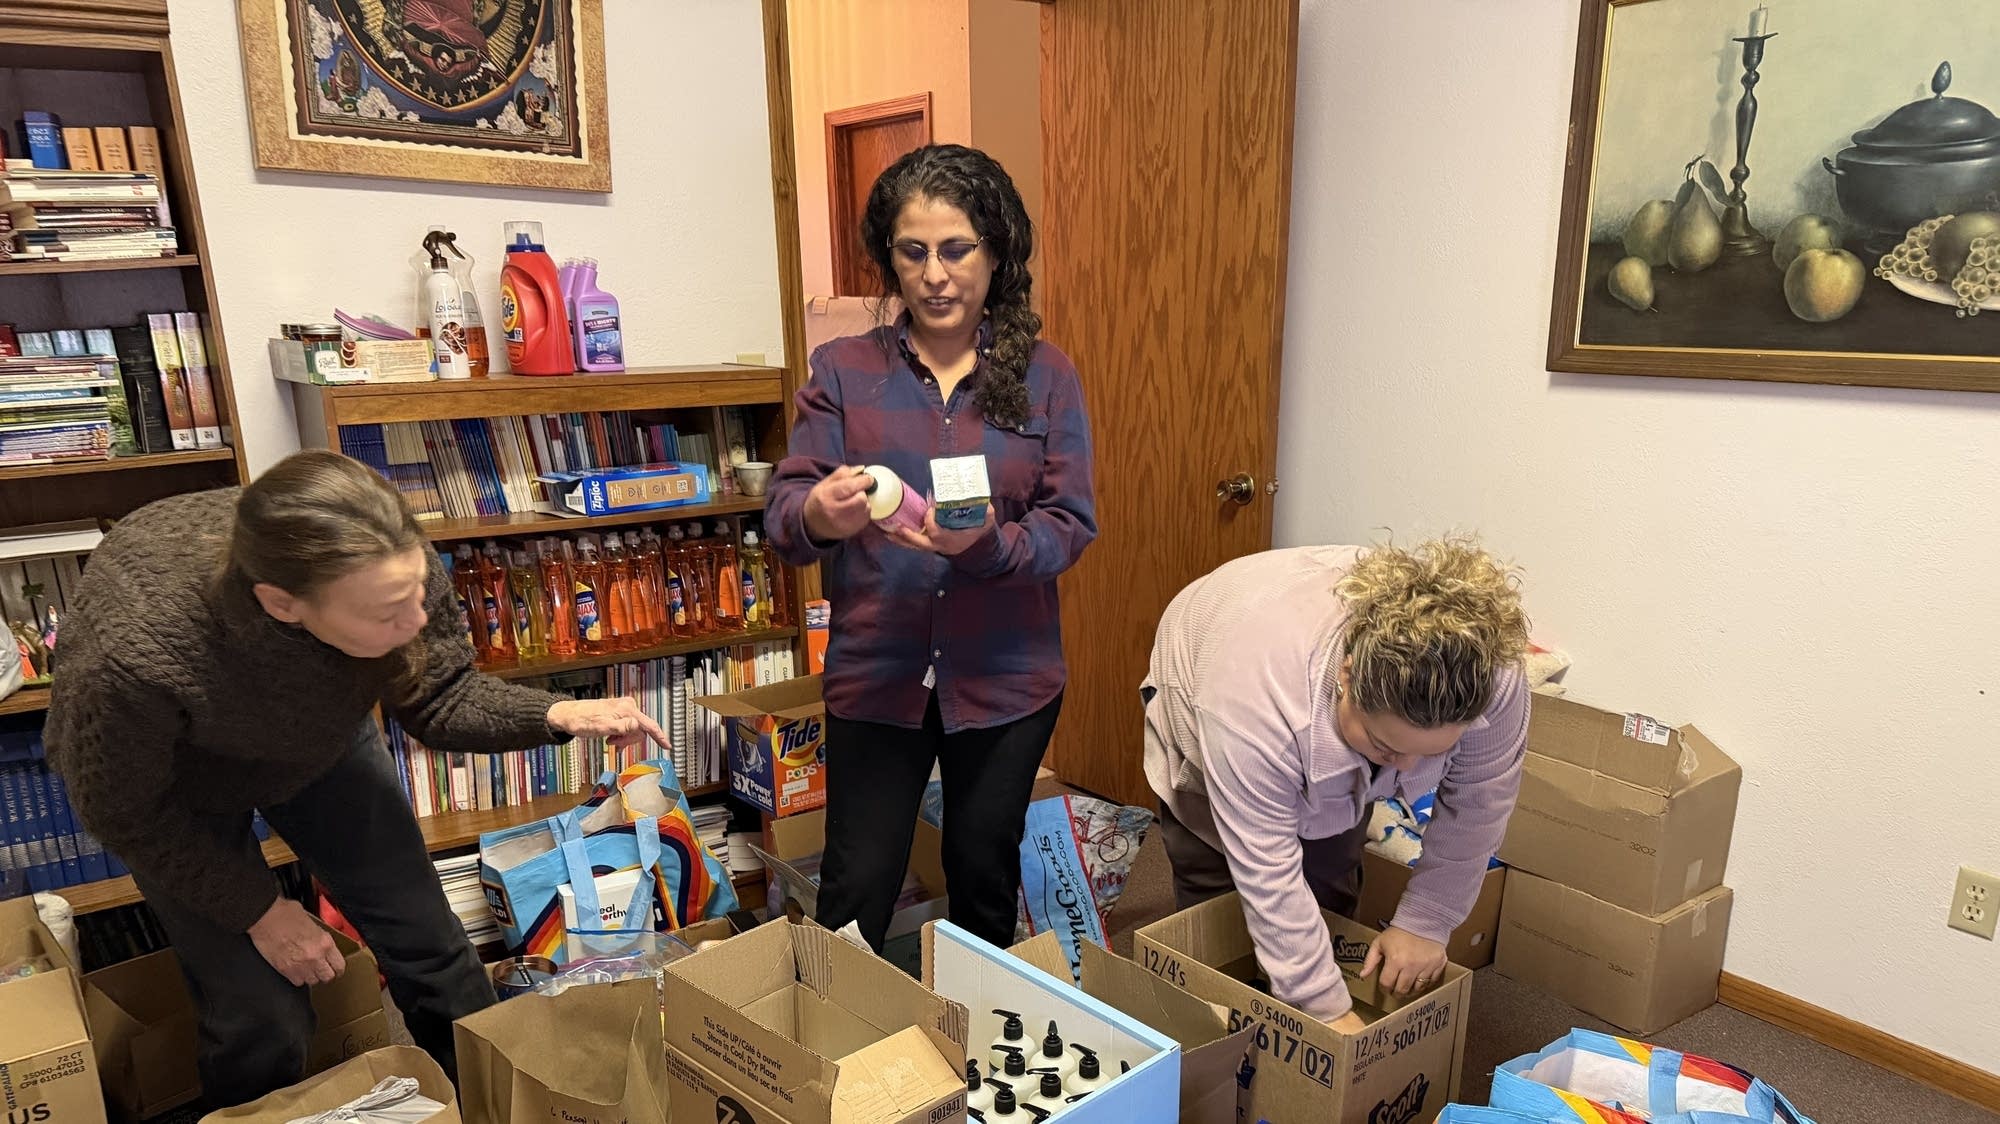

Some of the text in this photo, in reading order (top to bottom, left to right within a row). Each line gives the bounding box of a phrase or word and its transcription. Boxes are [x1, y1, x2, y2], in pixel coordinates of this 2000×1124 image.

[589, 480, 605, 511] Ziploc
[777, 716, 821, 761] Tide
[732, 770, 752, 795] 3X
[786, 763, 817, 781] PODS
[750, 779, 773, 798] Power
[758, 794, 773, 808] cold
[489, 906, 508, 919] ALDI
[600, 904, 616, 915] eal
[1336, 939, 1369, 958] Scott
[1143, 946, 1187, 987] 12/4's
[1265, 1006, 1304, 1036] 54000
[1392, 1006, 1449, 1055] 50617 02
[703, 1015, 715, 1030] This
[716, 1024, 729, 1039] Side
[762, 1055, 782, 1071] ouvrir
[707, 1030, 722, 1047] Store
[723, 1040, 729, 1051] in
[747, 1056, 759, 1071] Dry
[760, 1064, 777, 1081] Place
[1355, 1026, 1390, 1060] 12/4's
[57, 1051, 82, 1063] 72 CT
[691, 1032, 794, 1104] Entreposer dans un lieu sec et frais
[1305, 1047, 1333, 1085] 02
[8, 1102, 51, 1124] US
[931, 1098, 960, 1123] 901941
